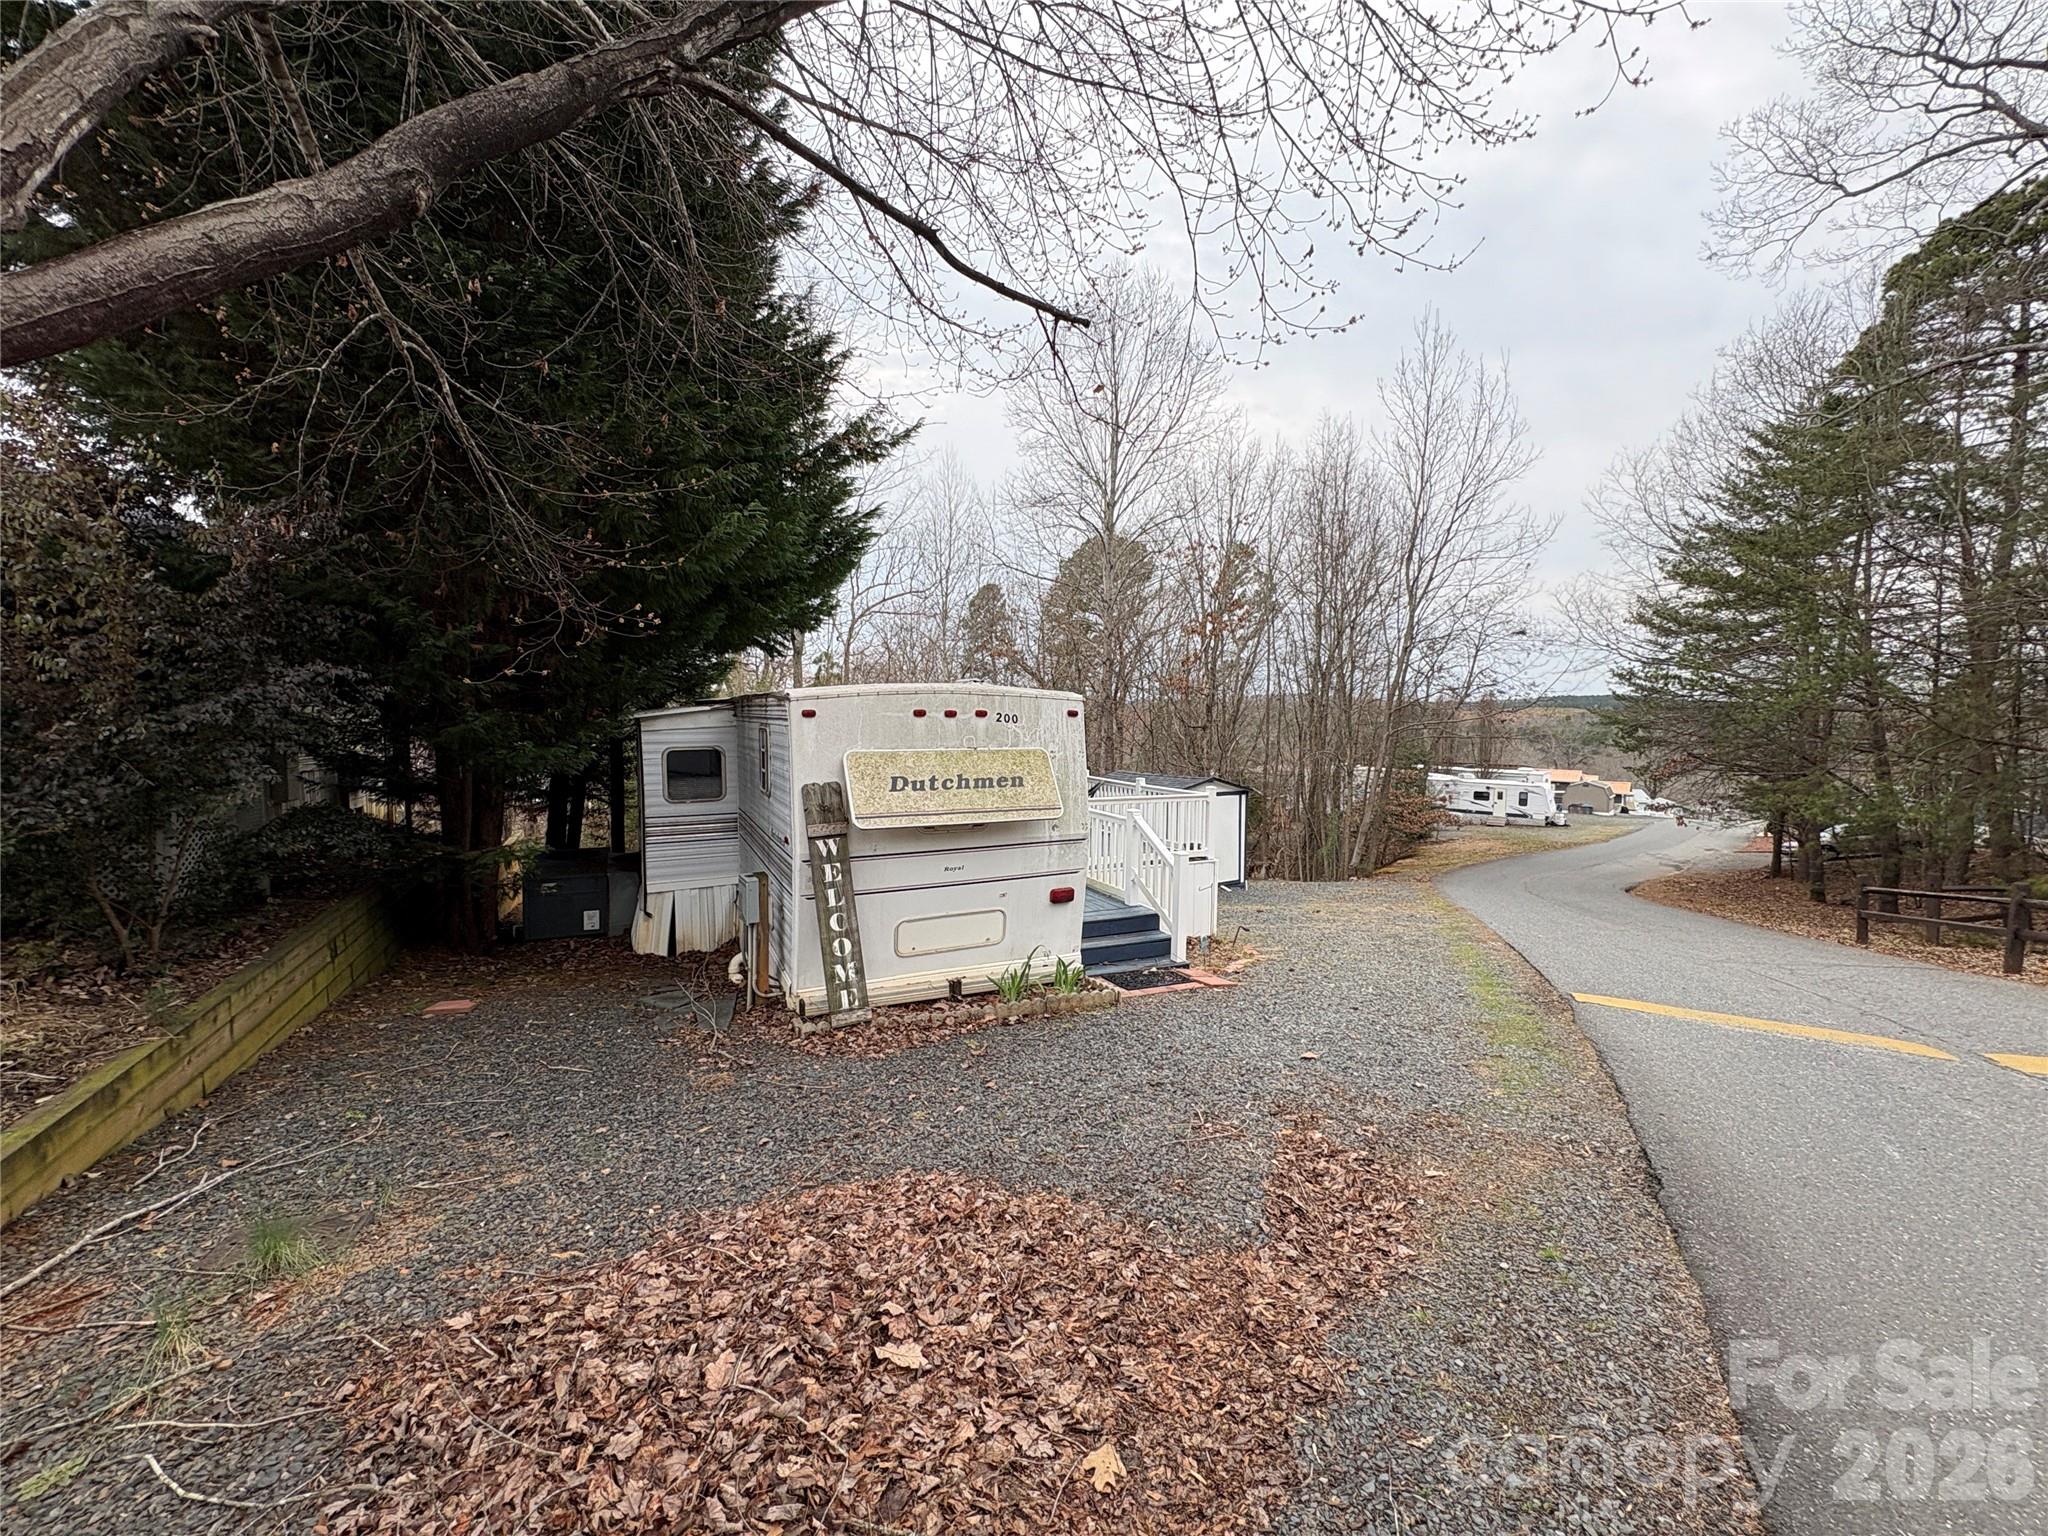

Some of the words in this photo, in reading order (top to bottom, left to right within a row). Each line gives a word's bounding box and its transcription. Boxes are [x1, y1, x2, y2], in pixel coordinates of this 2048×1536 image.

[995, 712, 1019, 724] 200
[889, 774, 1025, 793] Dutchmen
[943, 864, 965, 873] Royal
[815, 838, 860, 1010] WELCOME
